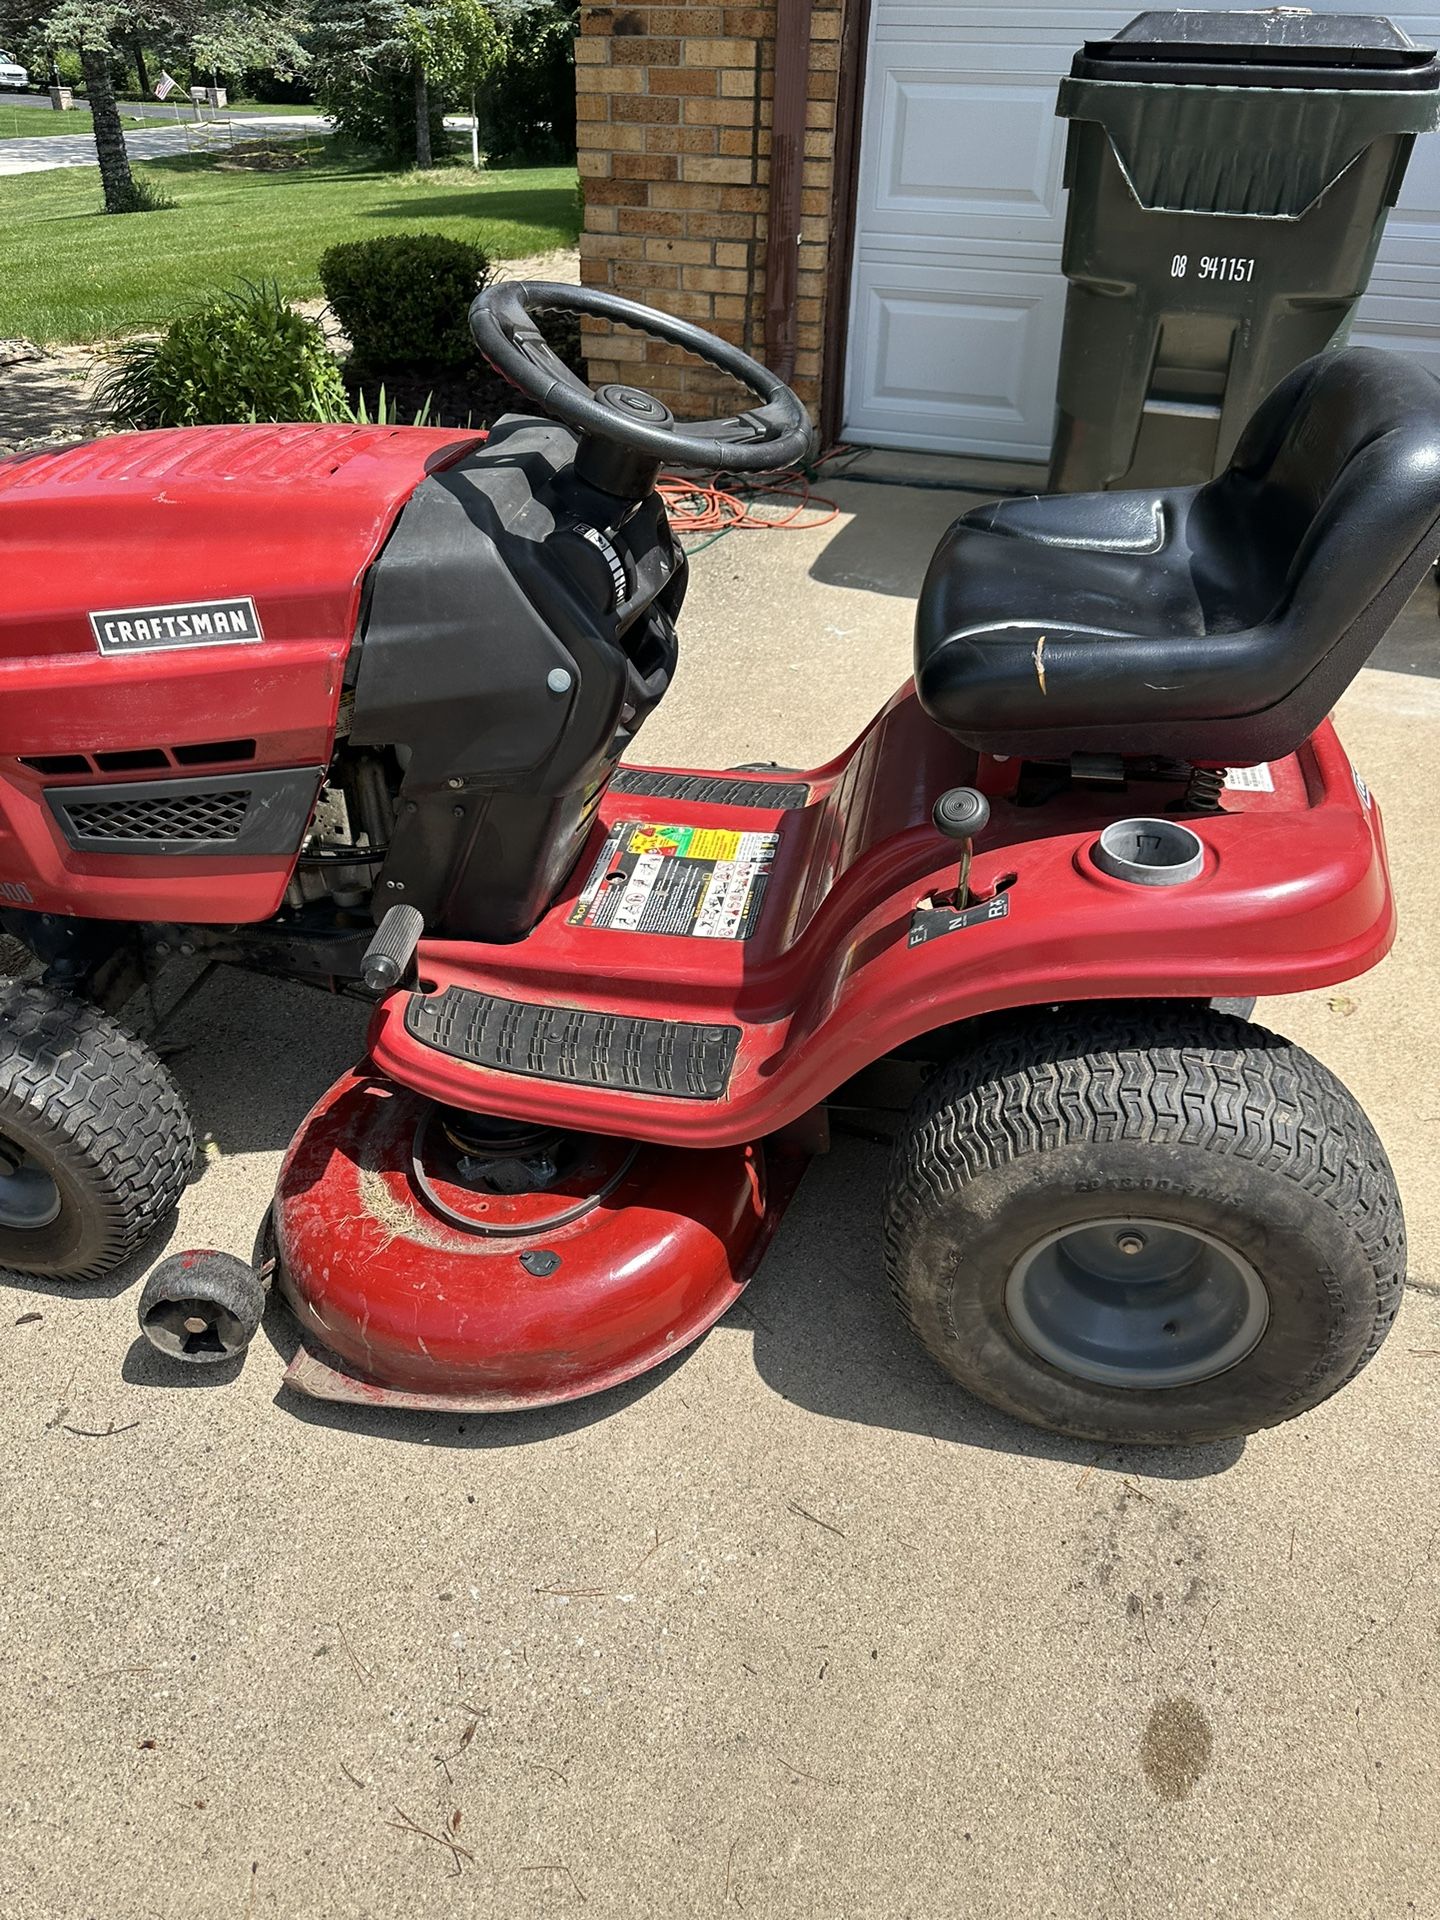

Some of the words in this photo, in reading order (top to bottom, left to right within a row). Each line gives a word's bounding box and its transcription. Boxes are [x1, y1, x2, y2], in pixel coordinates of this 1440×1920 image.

[1170, 254, 1188, 278] 08
[1197, 256, 1255, 282] 941151
[103, 609, 249, 644] CRAFTSMAN
[988, 907, 1003, 918] R
[948, 917, 962, 930] N
[910, 934, 923, 945] F
